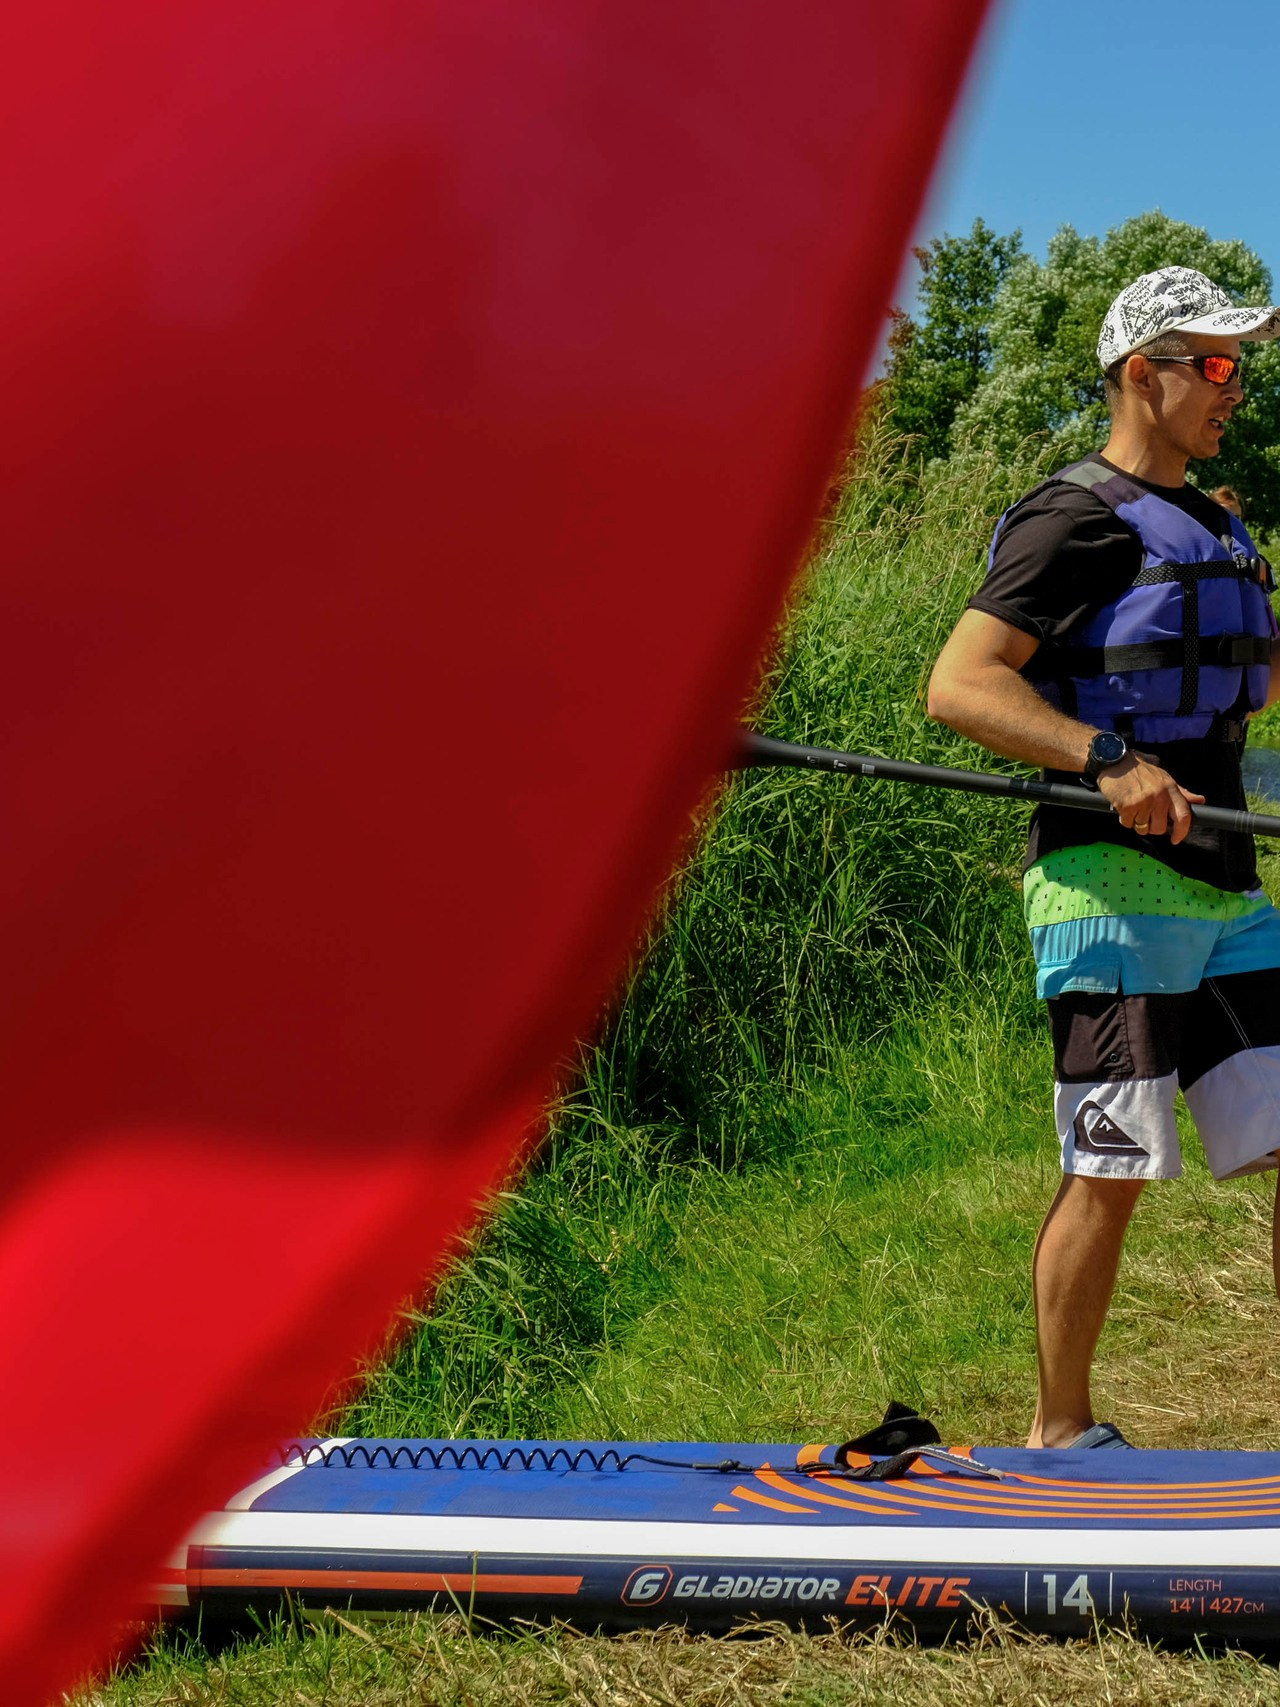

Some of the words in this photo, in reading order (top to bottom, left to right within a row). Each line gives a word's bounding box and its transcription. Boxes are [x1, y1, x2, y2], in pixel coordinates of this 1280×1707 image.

[844, 1575, 970, 1607] ELITE
[1042, 1574, 1094, 1615] 14
[1169, 1579, 1222, 1592] LENGTH
